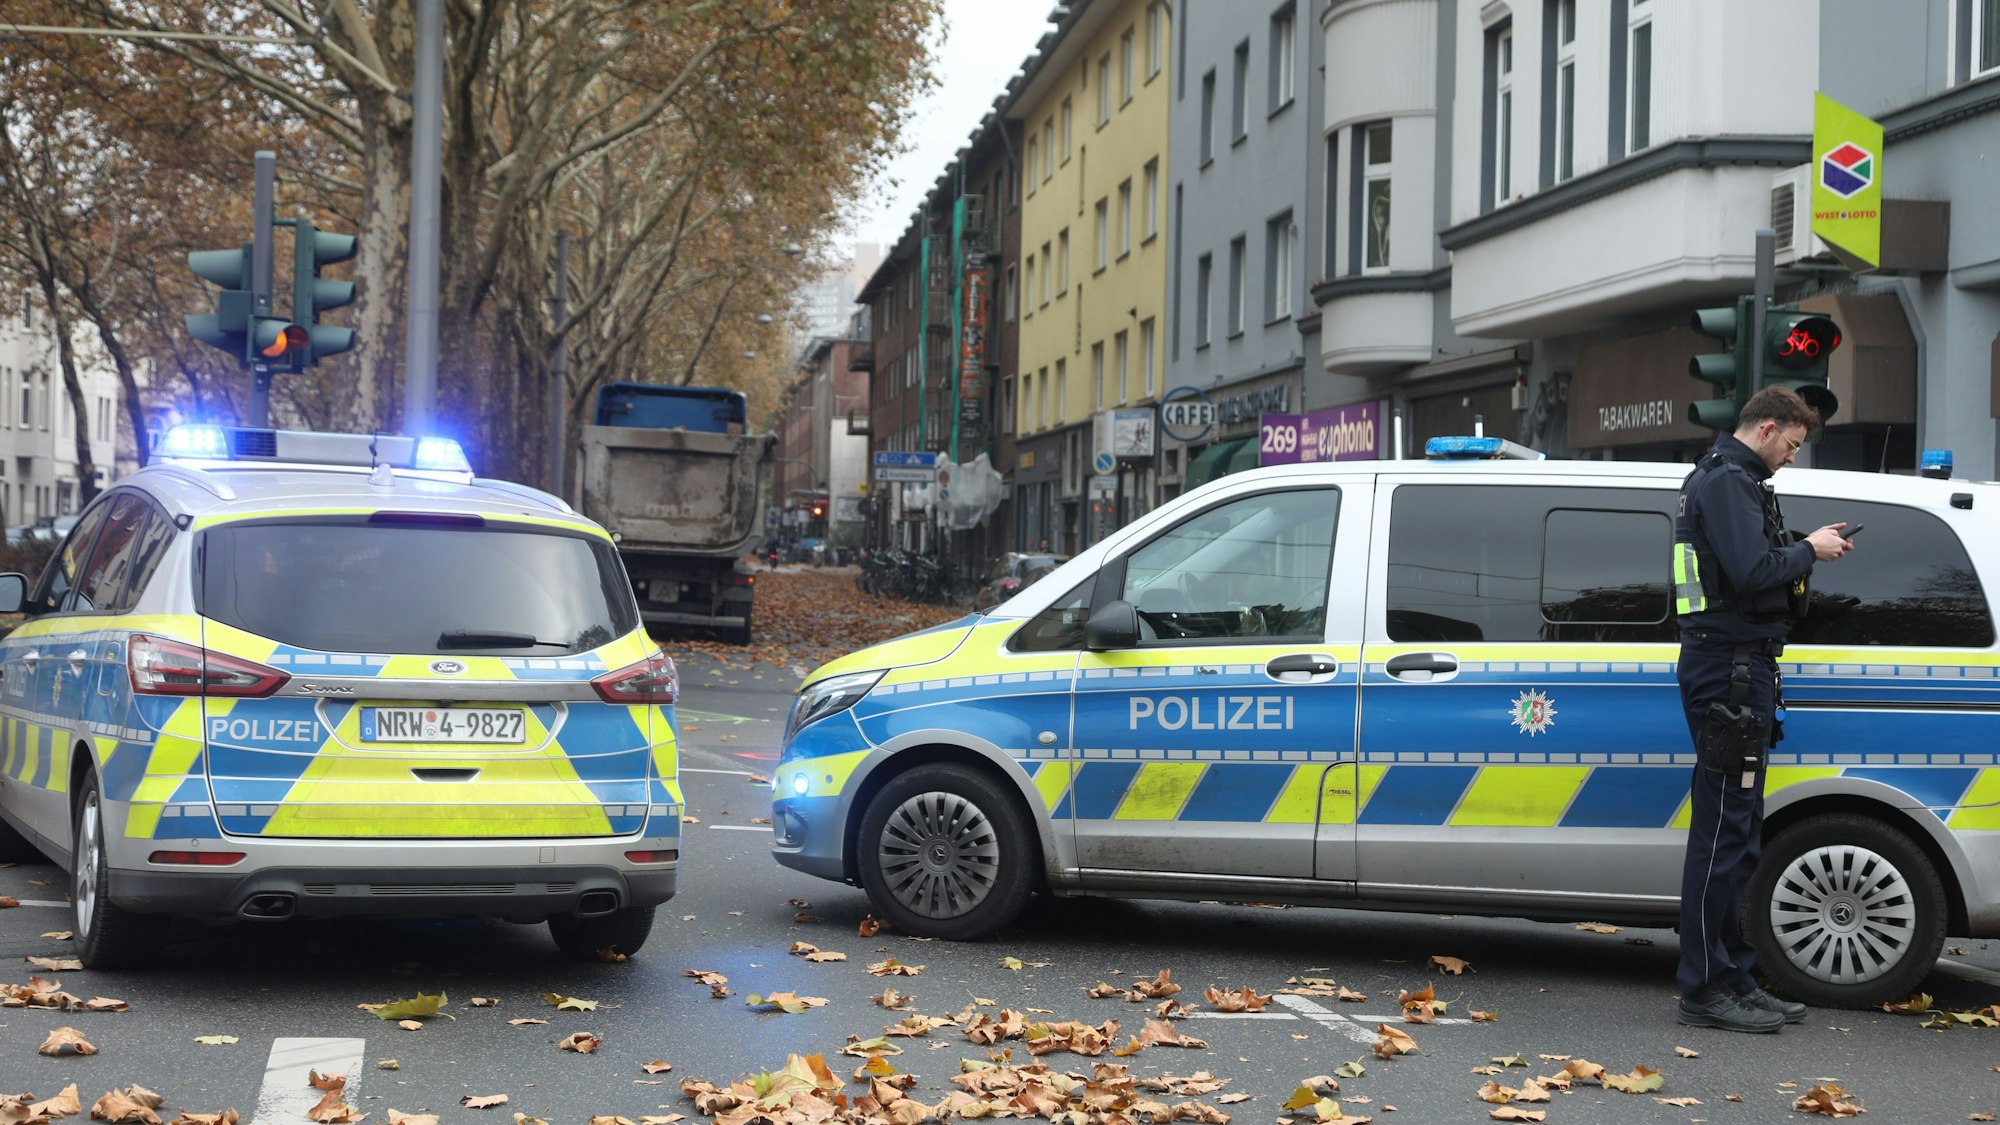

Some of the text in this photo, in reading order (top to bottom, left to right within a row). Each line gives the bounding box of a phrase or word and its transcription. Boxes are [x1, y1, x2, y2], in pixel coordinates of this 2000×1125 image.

[1815, 209, 1877, 220] WEST LOTTO
[1599, 399, 1673, 431] TABAKWAREN
[1261, 424, 1298, 453] 269
[1319, 407, 1374, 461] euphonia
[377, 711, 522, 738] NRW 4-9827
[1129, 696, 1294, 730] POLIZEI
[210, 719, 319, 742] POLIZEI
